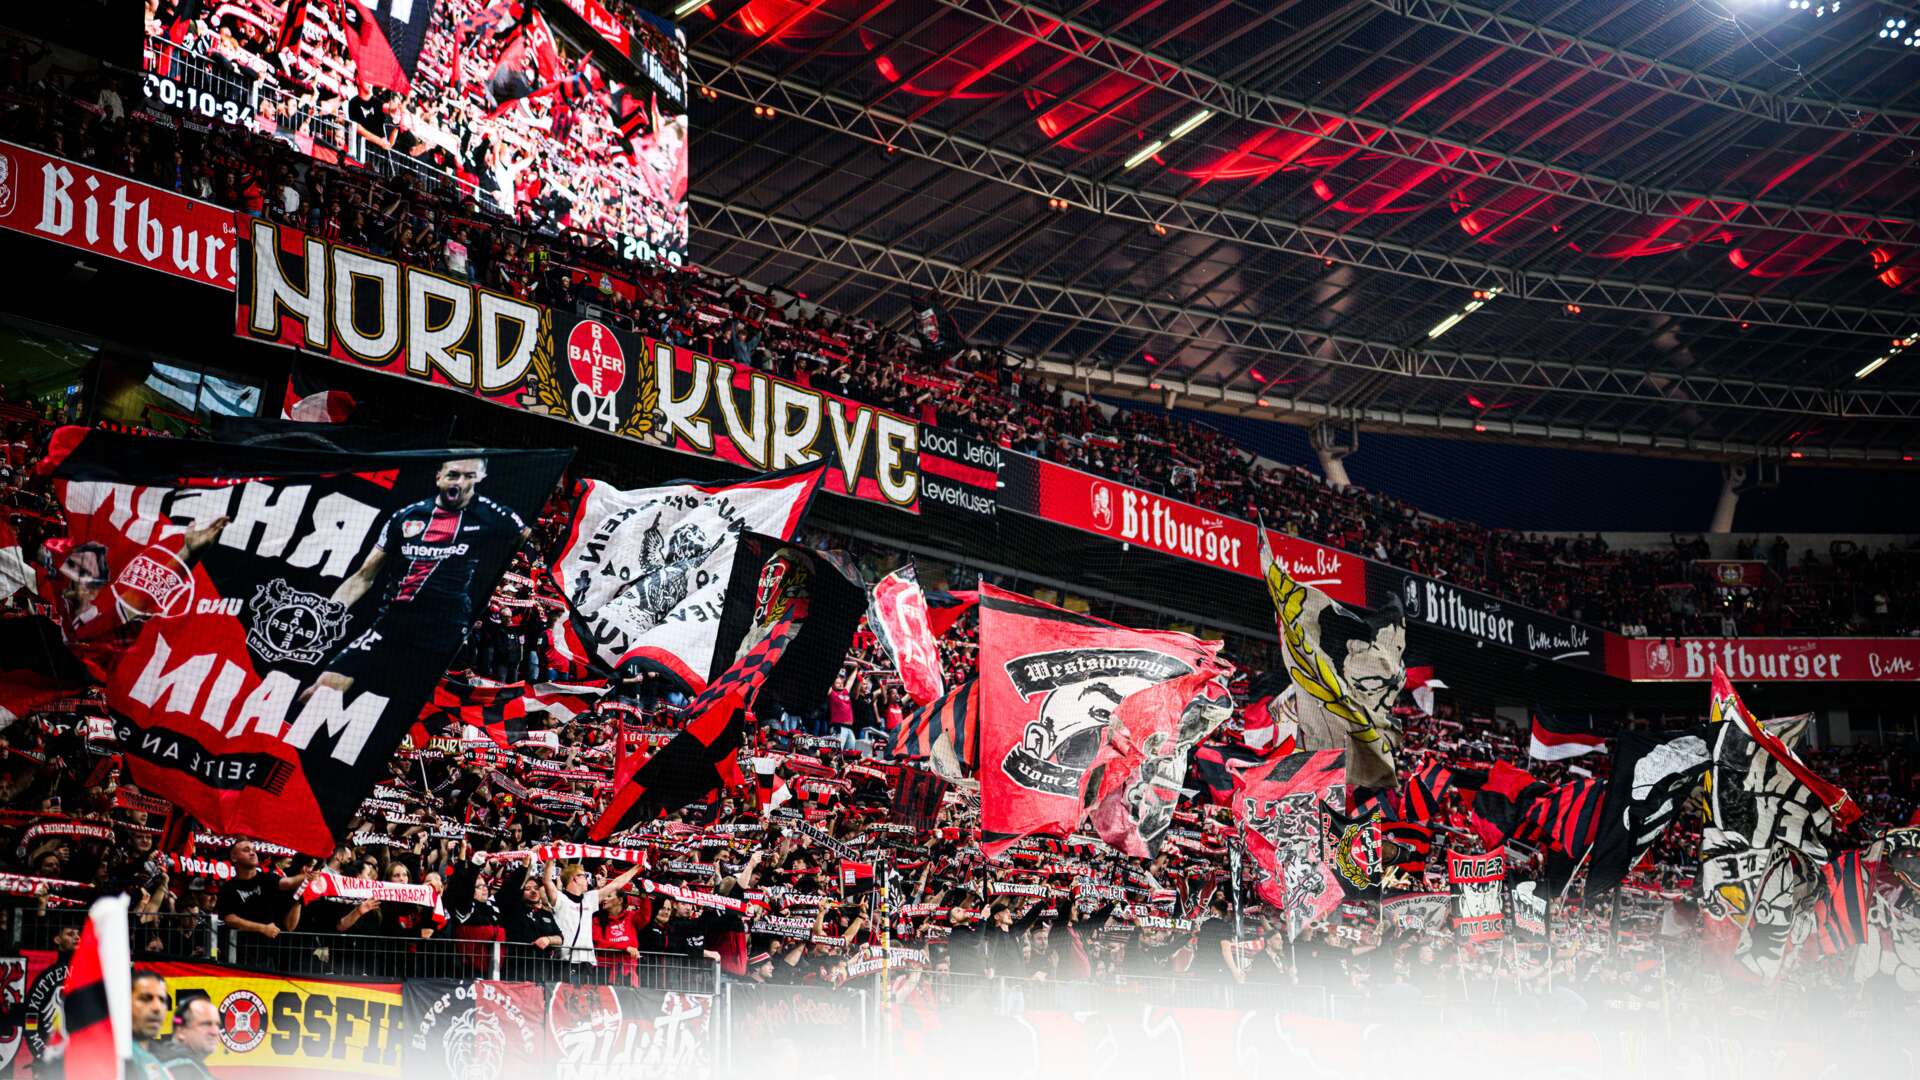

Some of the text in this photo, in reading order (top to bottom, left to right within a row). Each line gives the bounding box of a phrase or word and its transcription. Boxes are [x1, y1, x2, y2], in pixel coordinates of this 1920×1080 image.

[248, 216, 920, 511] NORD KURVE
[569, 344, 623, 374] BAYER
[571, 383, 620, 432] 04
[920, 427, 958, 457] Jood
[1120, 488, 1241, 569] Bitburger
[1293, 556, 1316, 575] ein
[1317, 547, 1342, 576] Bit
[1425, 581, 1514, 645] Bitburger
[1527, 623, 1551, 650] Bitte
[1570, 624, 1589, 648] Bit
[1684, 640, 1842, 678] Bitburger
[1868, 652, 1914, 678] Bitte
[180, 855, 216, 874] FORZA
[342, 876, 385, 889] KICKERS
[682, 888, 694, 898] 04
[29, 964, 74, 1011] KUTTEN
[412, 992, 451, 1051] Bayer
[455, 983, 477, 1000] 04
